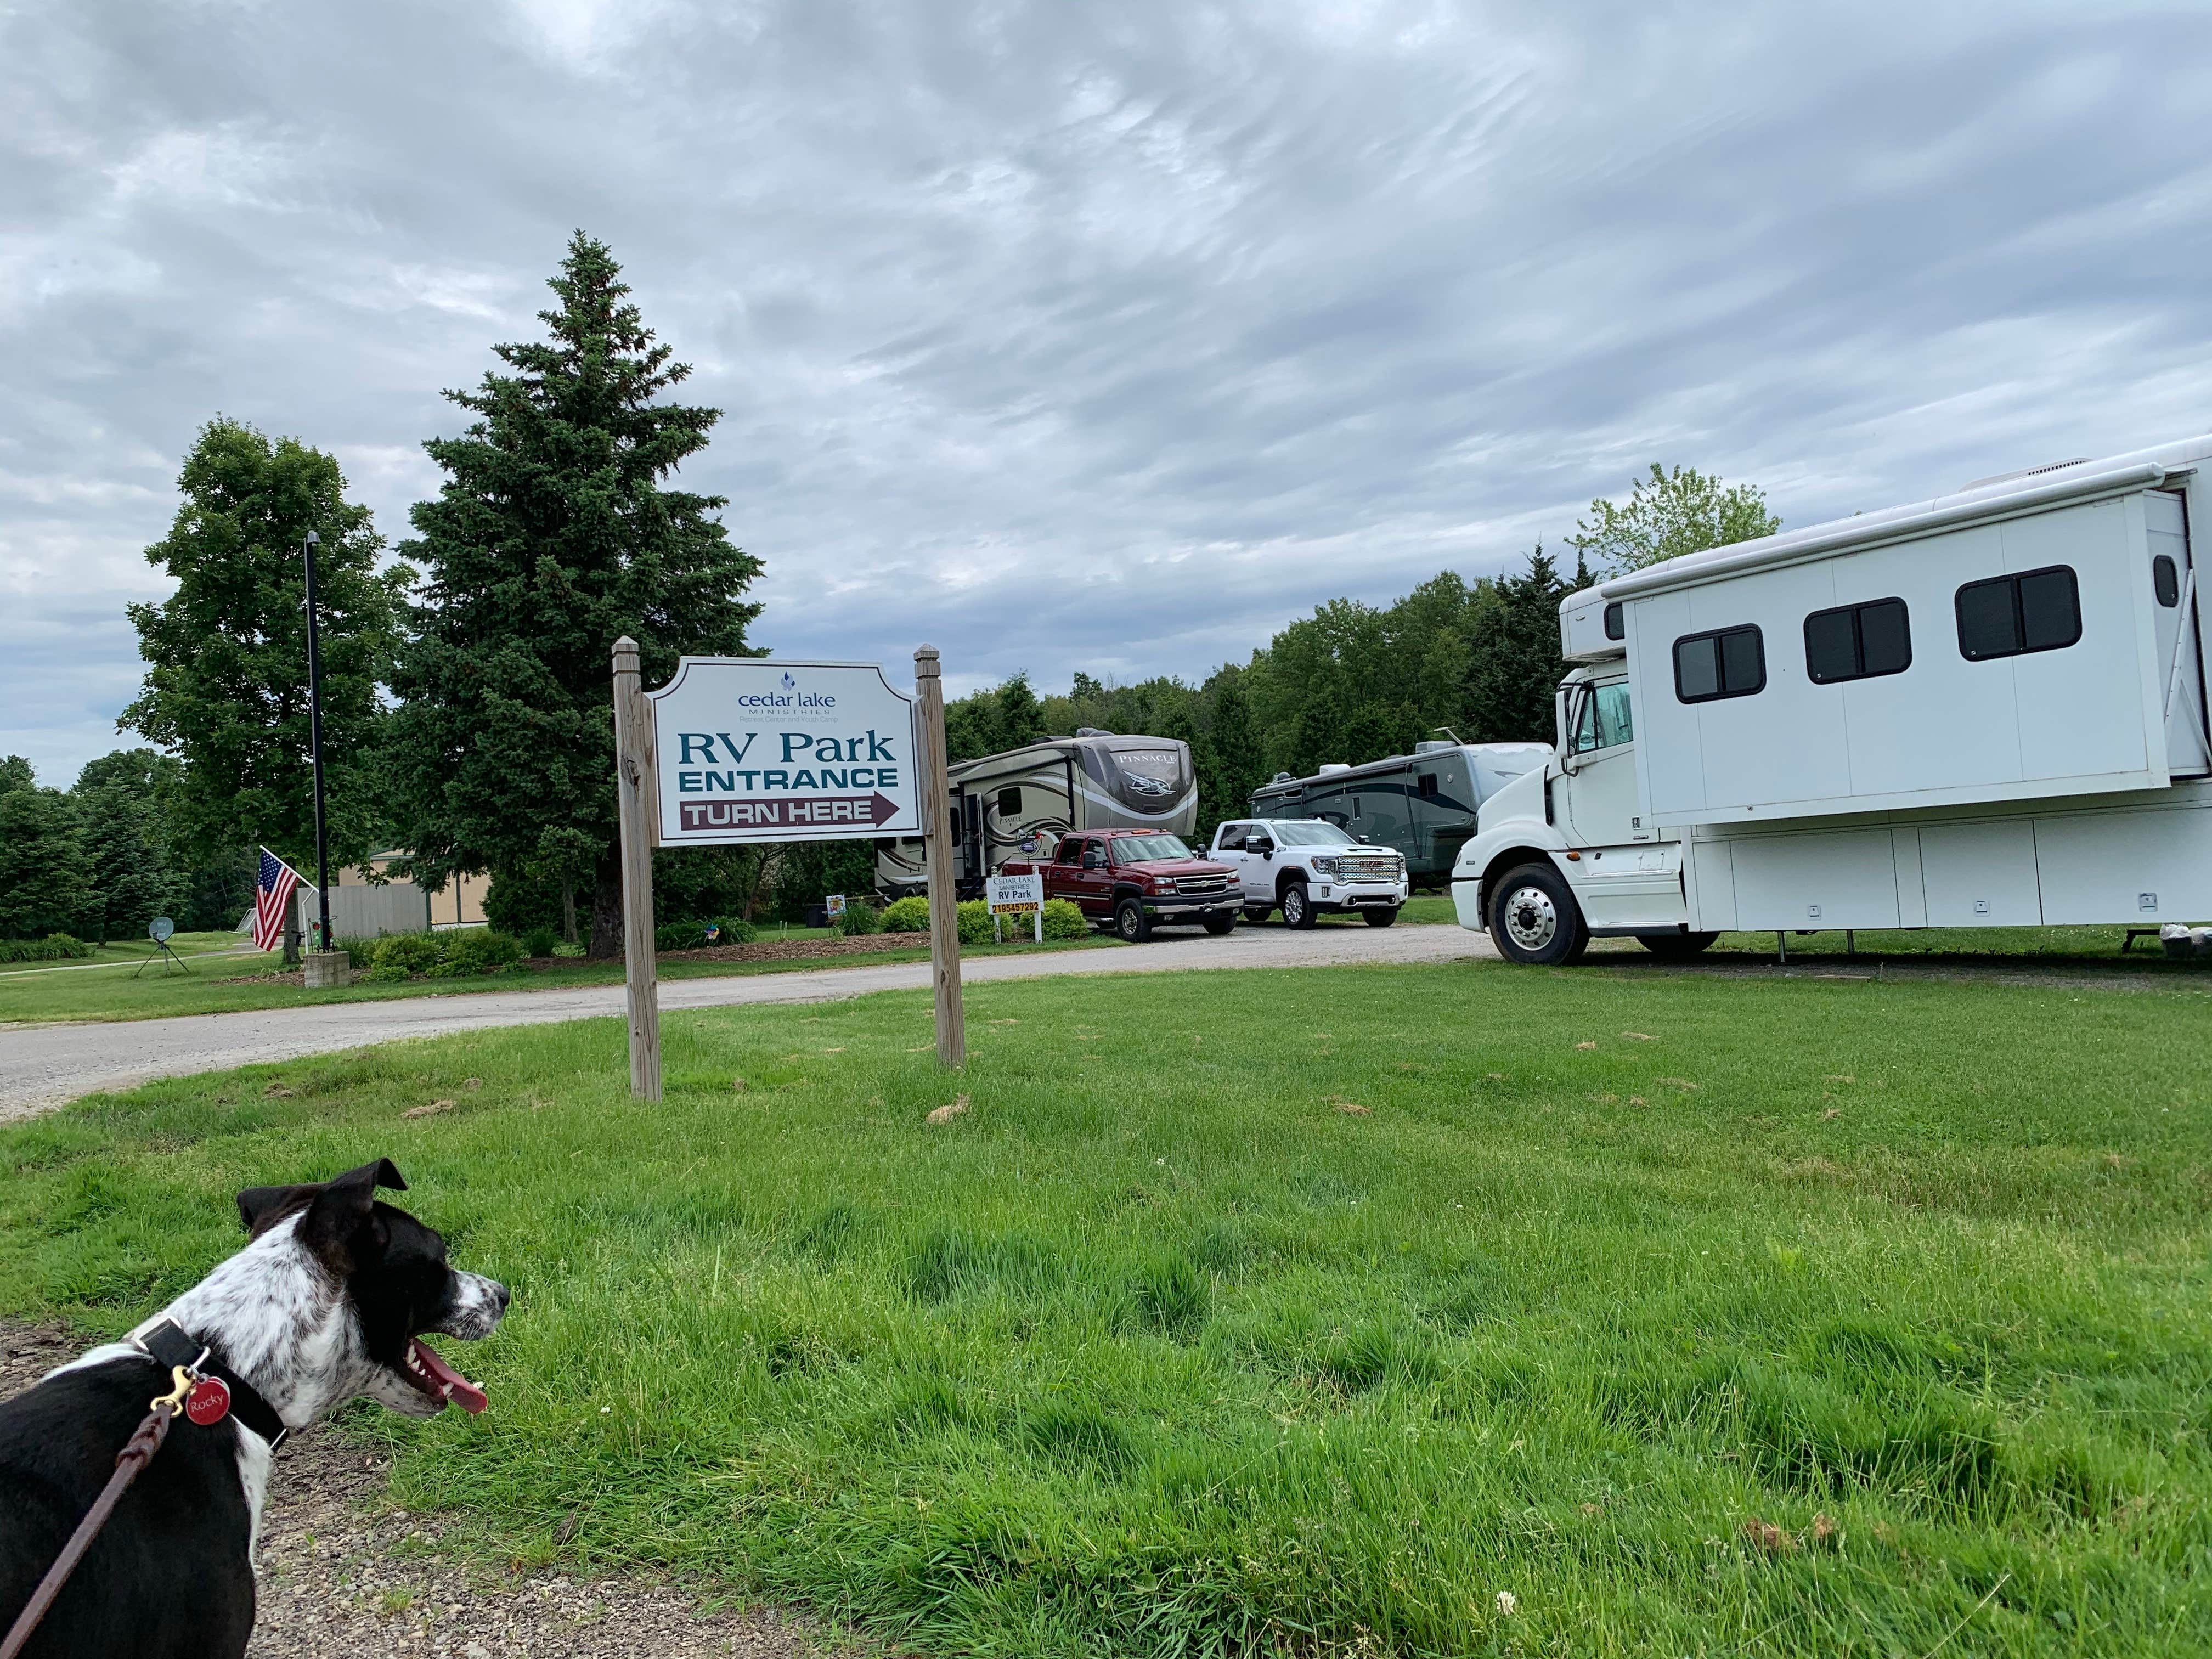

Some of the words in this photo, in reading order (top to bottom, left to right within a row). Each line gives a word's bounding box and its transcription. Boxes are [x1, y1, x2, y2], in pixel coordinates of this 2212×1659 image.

[738, 692, 793, 707] cedar
[798, 692, 836, 707] lake
[678, 732, 758, 764] RV
[779, 730, 896, 763] Park
[1119, 754, 1177, 763] PINNACLE
[679, 768, 899, 792] ENTRANCE
[684, 802, 780, 826] TURN
[788, 800, 872, 822] HERE
[999, 816, 1022, 825] PINNACLE
[998, 891, 1009, 900] RV
[1012, 890, 1031, 899] Park
[992, 902, 1039, 913] 2195457292
[190, 1394, 223, 1412] Rocky
